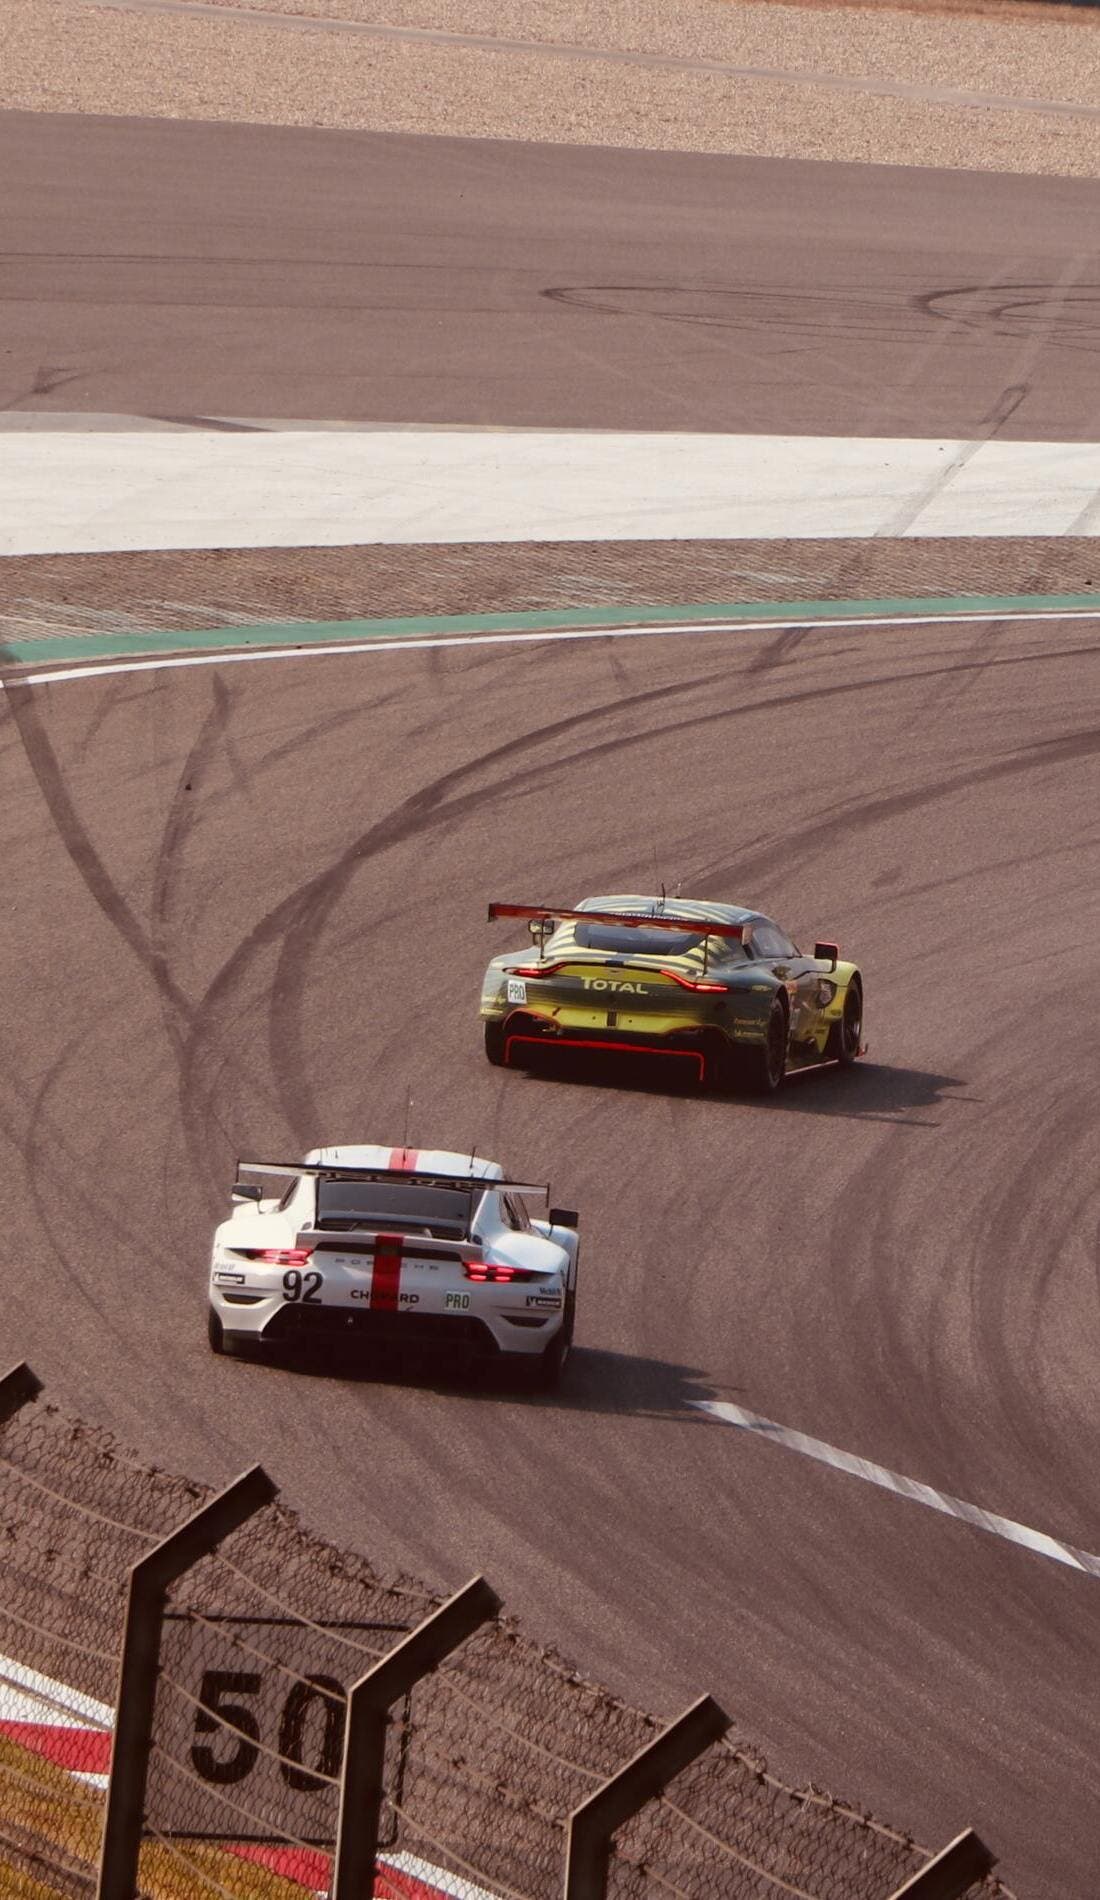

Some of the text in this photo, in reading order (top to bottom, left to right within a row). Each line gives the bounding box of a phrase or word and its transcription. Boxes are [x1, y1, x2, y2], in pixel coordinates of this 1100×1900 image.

[509, 984, 525, 1000] PRO
[580, 976, 648, 994] TOTAL
[282, 1269, 324, 1304] 92
[351, 1289, 420, 1304] CHRD
[446, 1293, 470, 1309] PRO
[191, 1671, 348, 1791] 50
